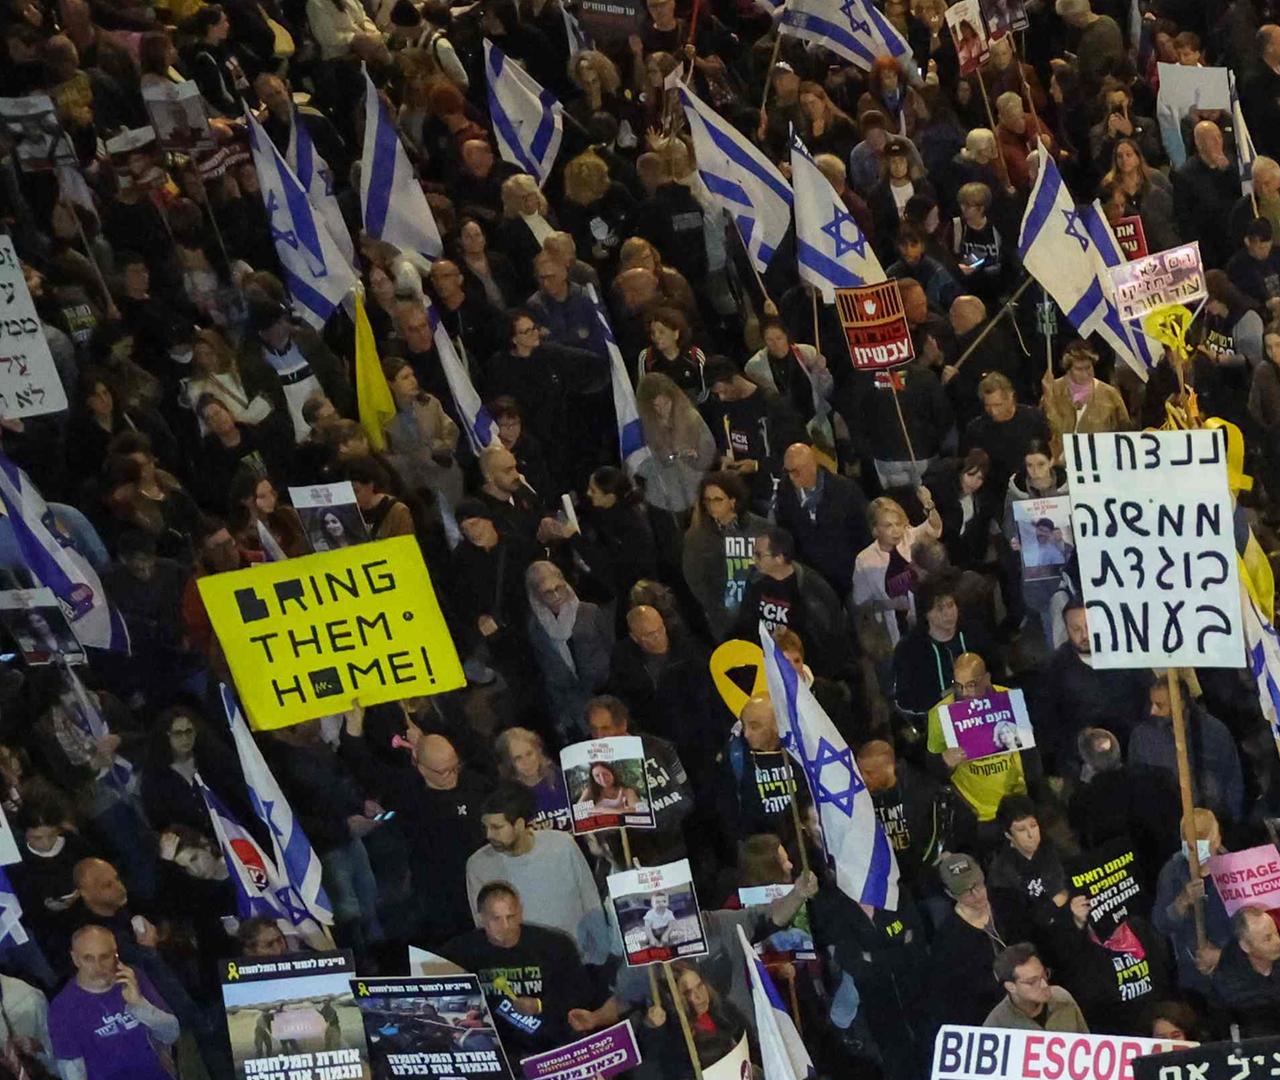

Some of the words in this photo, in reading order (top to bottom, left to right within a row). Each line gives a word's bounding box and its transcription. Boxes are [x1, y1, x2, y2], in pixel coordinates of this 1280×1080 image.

[1075, 498, 1221, 540] ממשלה
[1092, 547, 1229, 592] בוגדת
[235, 560, 397, 625] BRING
[250, 611, 393, 664] THEM
[272, 646, 437, 708] HOME!
[986, 710, 1011, 723] העם
[651, 791, 682, 811] WAR
[1214, 861, 1279, 886] HOSTAGE
[244, 1053, 317, 1074] המלחמה
[319, 1048, 360, 1066] אחרת
[386, 1052, 449, 1065] המלחמה
[452, 1049, 498, 1062] אחרת
[938, 1031, 1012, 1077] BIBI
